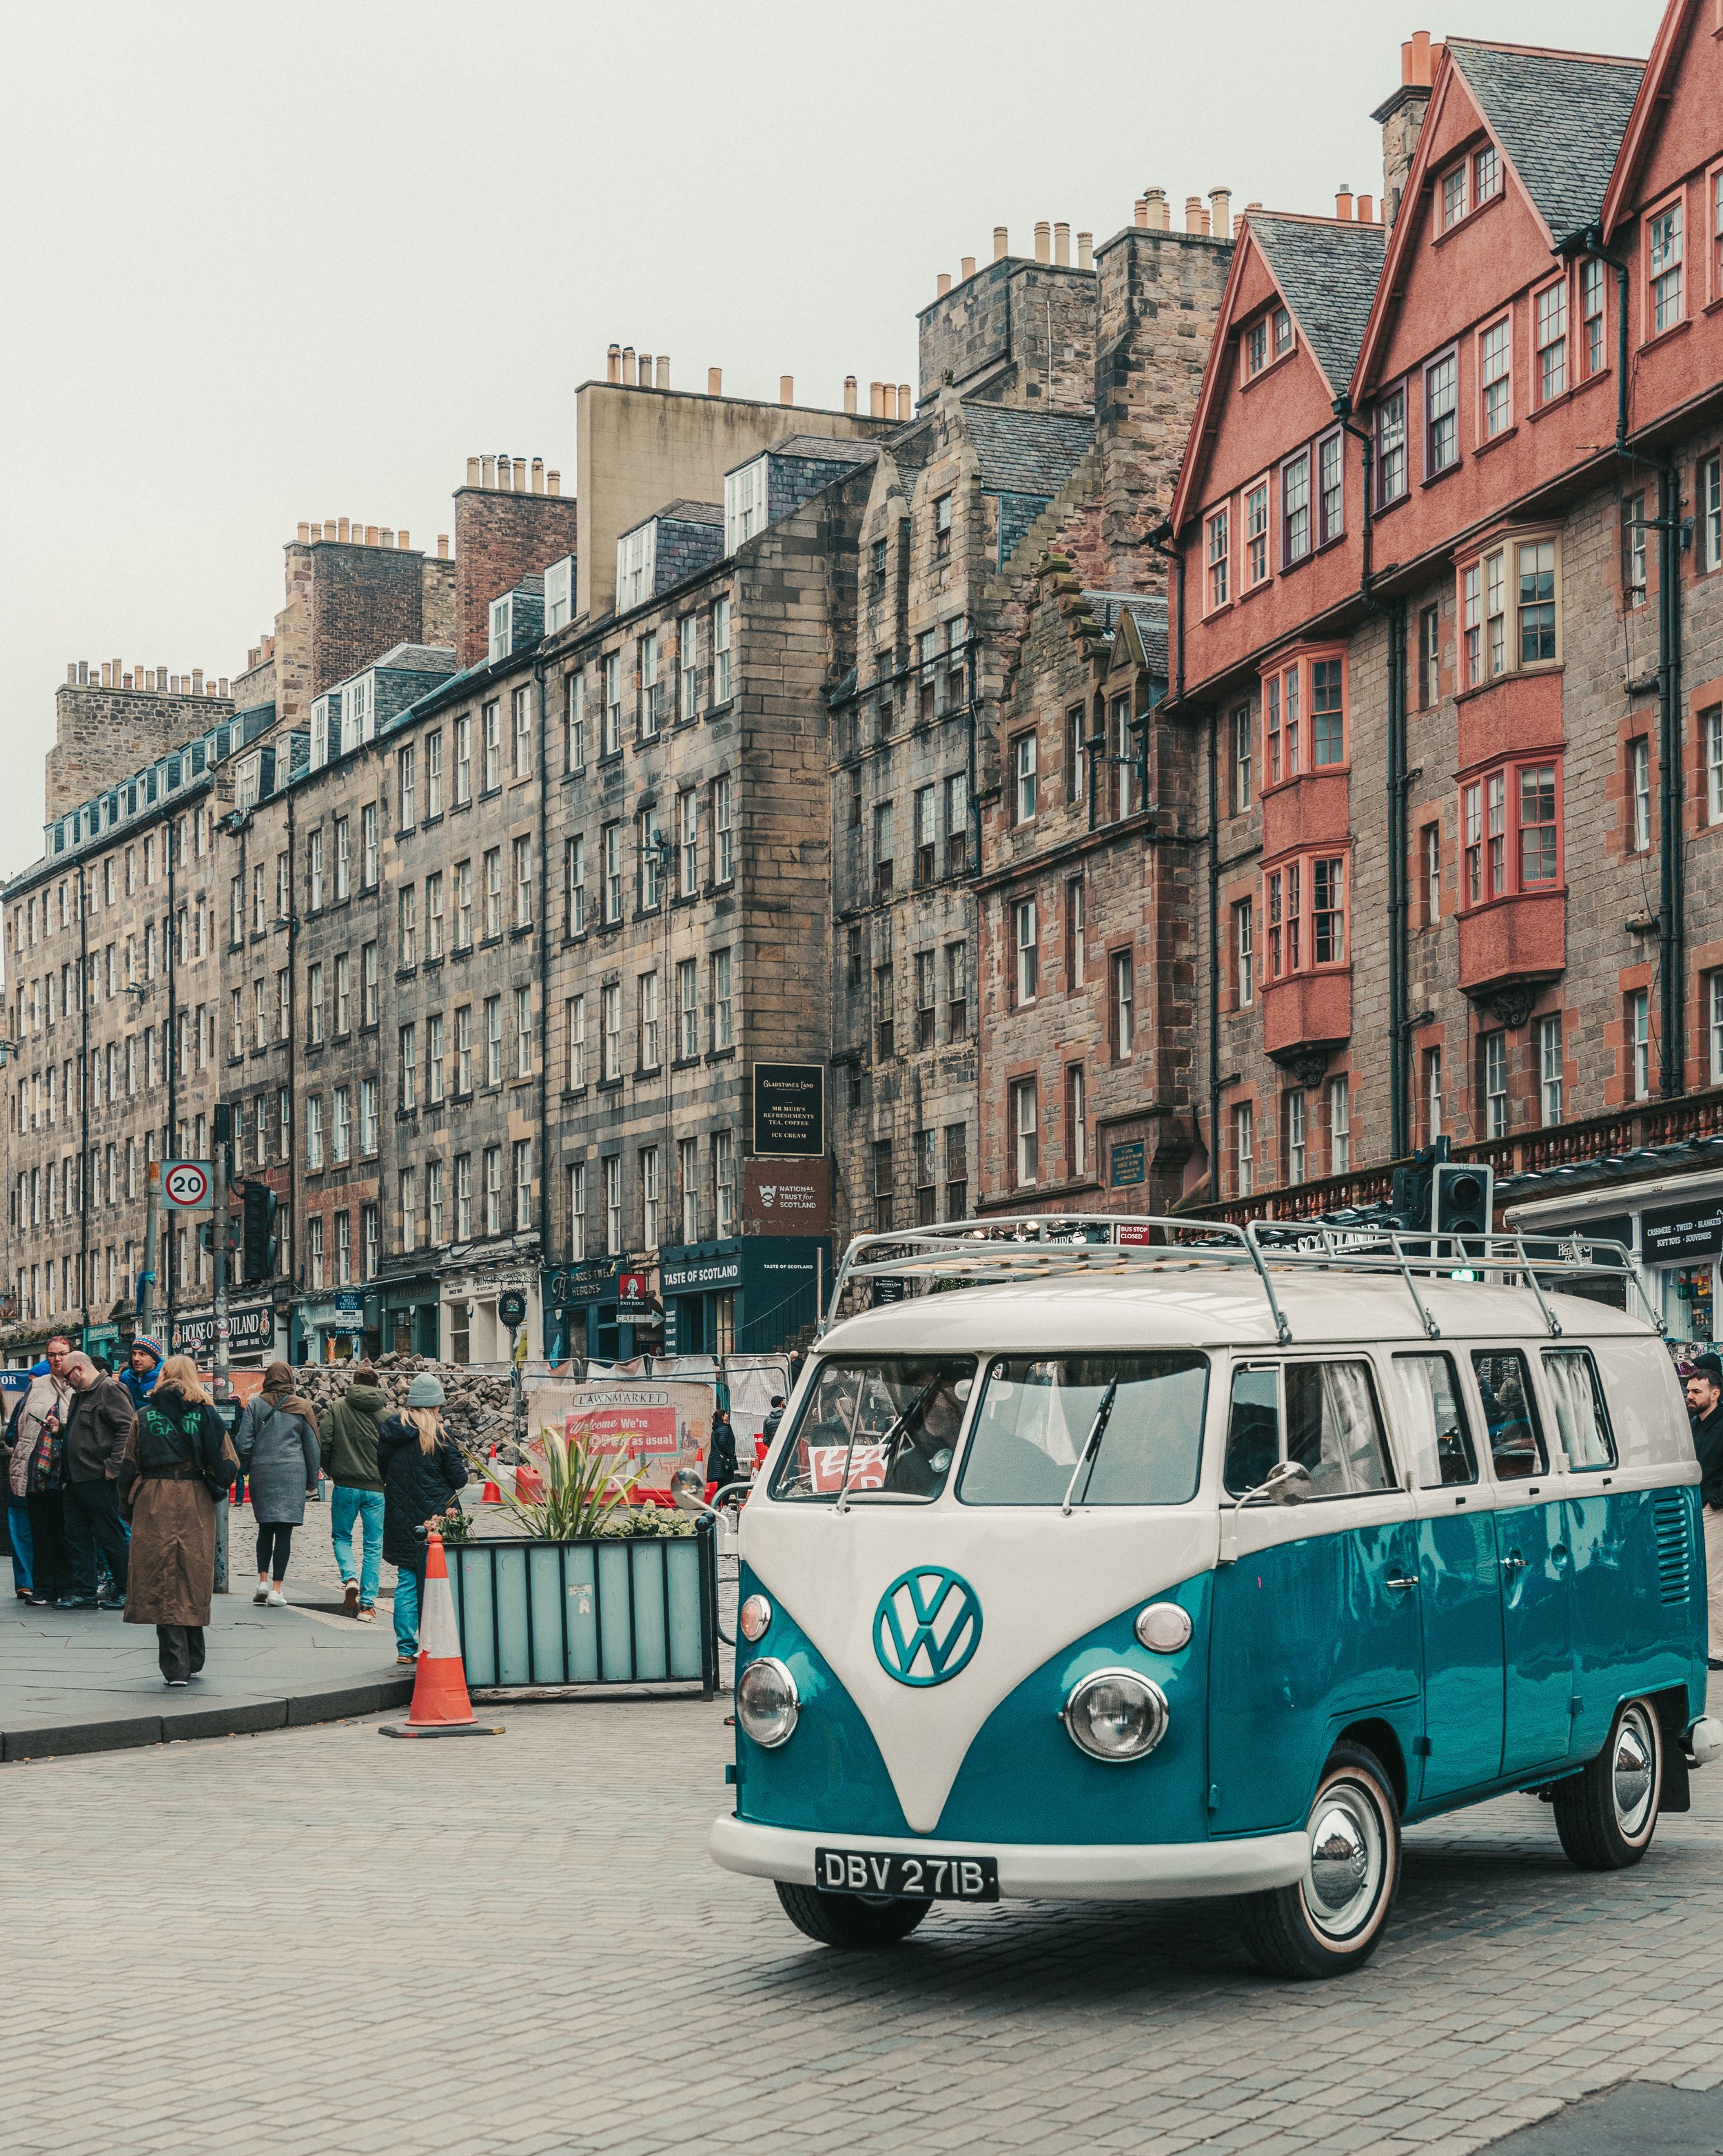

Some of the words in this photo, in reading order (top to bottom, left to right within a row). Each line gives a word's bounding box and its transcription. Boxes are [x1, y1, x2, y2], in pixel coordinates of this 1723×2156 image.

[174, 1176, 201, 1193] 20
[1647, 1226, 1671, 1236] CASHMERE
[1675, 1222, 1693, 1232] TWEED
[1697, 1218, 1722, 1228] BLANKETS
[1657, 1239, 1668, 1247] SOFT
[1669, 1237, 1681, 1245] TOYS
[1686, 1231, 1712, 1242] SOUVENIRS
[664, 1271, 686, 1286] TASTE
[687, 1270, 697, 1282] OF
[699, 1265, 738, 1281] SCOTLAND
[572, 1284, 601, 1296] HEBRIDES
[182, 1322, 205, 1343] HOUSE
[580, 1393, 662, 1405] LAWNMARKET
[569, 1418, 618, 1434] Welcome
[620, 1418, 648, 1428] We're
[632, 1437, 644, 1446] as
[646, 1435, 673, 1446] usual
[825, 1854, 891, 1889] DBV
[901, 1860, 984, 1894] 271B
